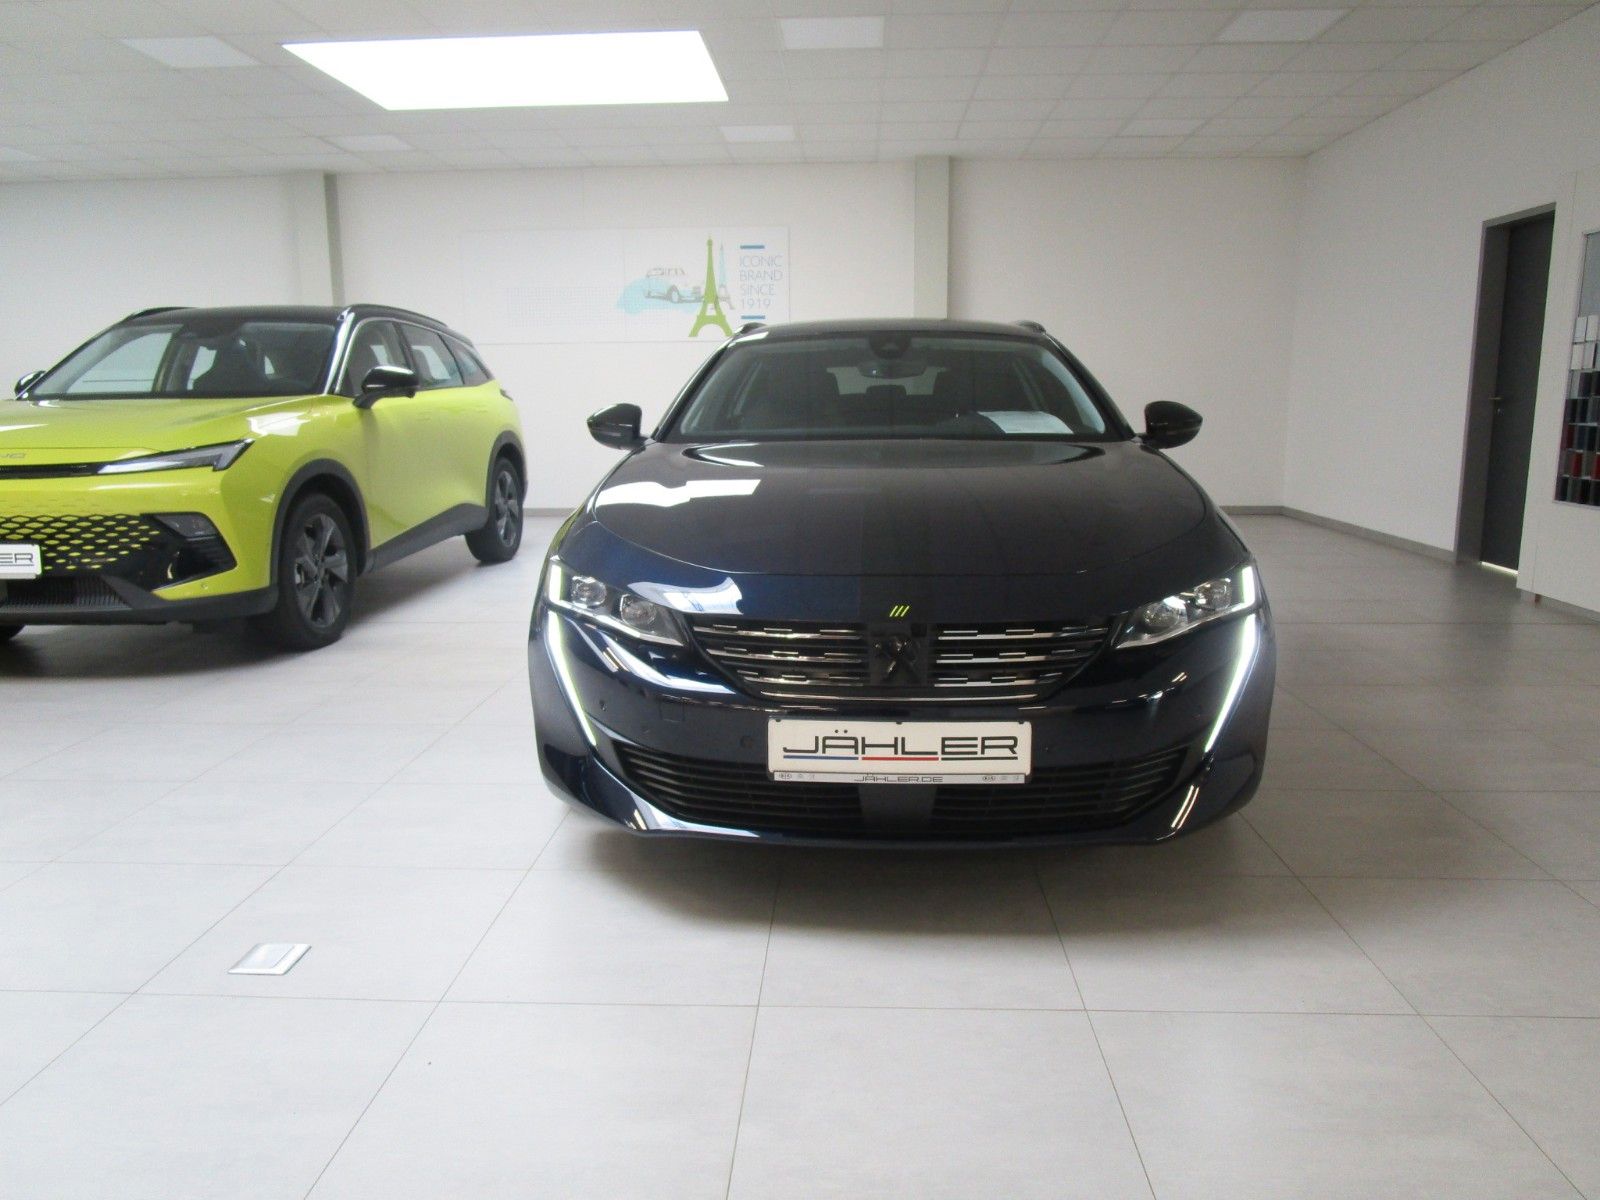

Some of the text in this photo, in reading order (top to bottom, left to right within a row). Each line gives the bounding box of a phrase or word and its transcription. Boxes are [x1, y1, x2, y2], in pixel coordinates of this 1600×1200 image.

[740, 255, 783, 268] ICONIC
[740, 269, 783, 281] BRAND
[740, 283, 776, 296] SINCE
[741, 298, 770, 309] 1919
[783, 729, 1019, 756] JÄHLER
